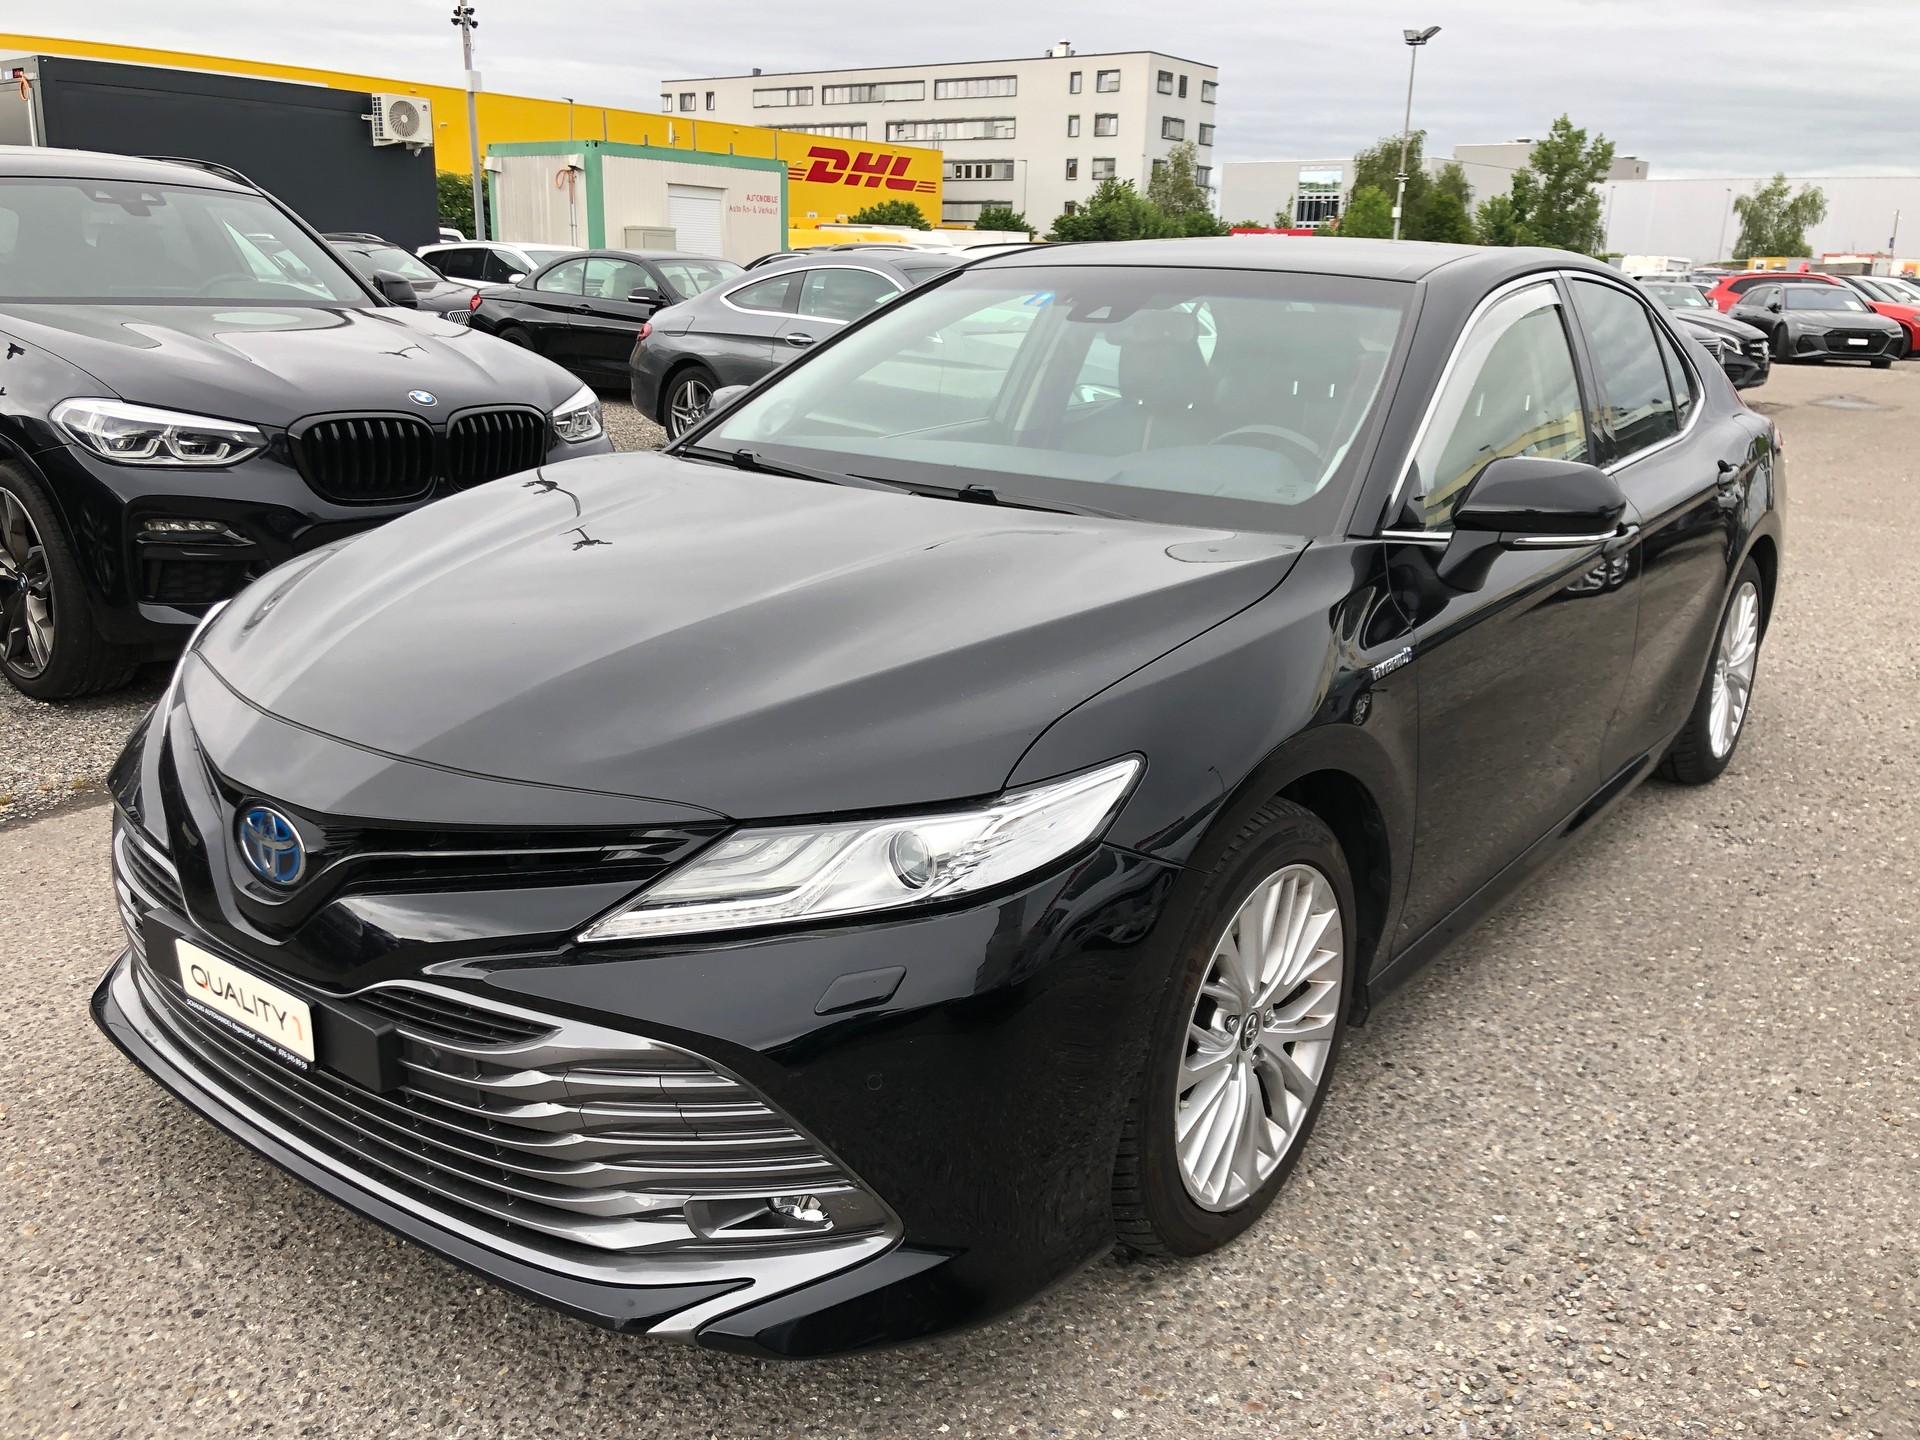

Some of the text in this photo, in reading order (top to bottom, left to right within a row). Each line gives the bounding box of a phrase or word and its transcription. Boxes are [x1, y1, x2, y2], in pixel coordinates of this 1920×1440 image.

[805, 146, 917, 191] DHL
[191, 964, 303, 1041] QUALITY 1
